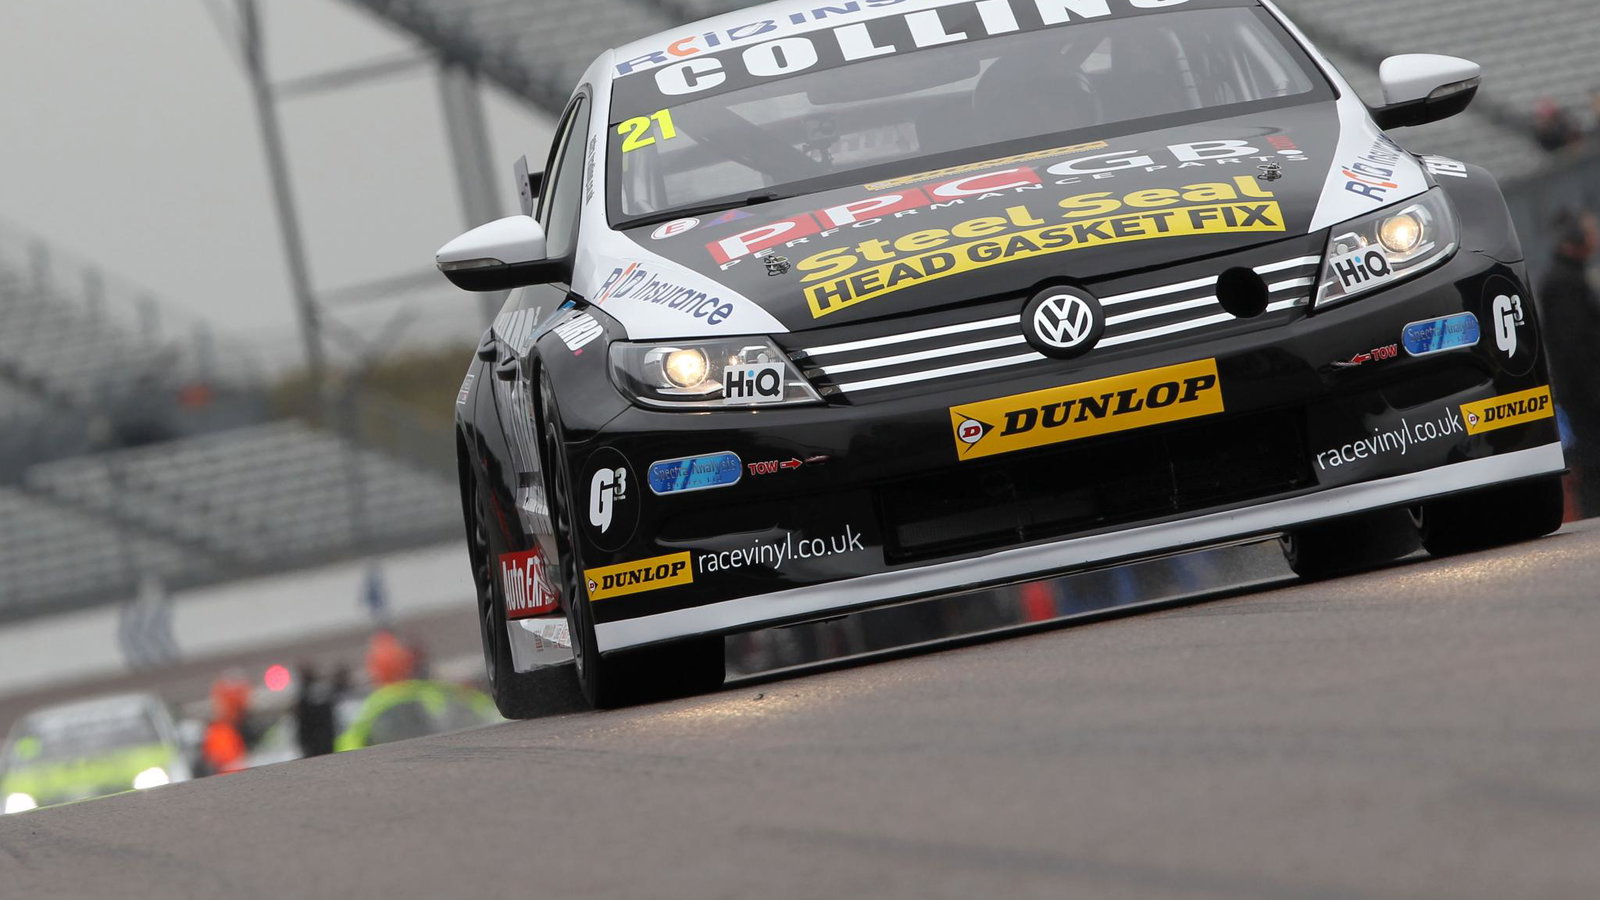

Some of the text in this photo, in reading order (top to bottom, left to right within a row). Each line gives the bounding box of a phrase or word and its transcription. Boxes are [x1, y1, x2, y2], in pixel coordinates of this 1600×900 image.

[655, 0, 1190, 95] COLLIN
[617, 109, 676, 152] 21
[719, 170, 1115, 271] PERFORMANCE
[1145, 154, 1308, 172] PARTS
[796, 175, 1274, 282] Steel Seal
[813, 204, 1278, 310] HEAD GASKET FIX
[1335, 251, 1391, 288] HiQ
[630, 273, 734, 325] Insurance
[1371, 344, 1397, 361] TOW
[725, 368, 780, 397] HiQ
[1000, 374, 1216, 437] DUNLOP
[1483, 394, 1549, 423] DUNLOP
[1317, 407, 1463, 470] racevinyl.co.uk
[748, 459, 779, 475] TOW
[699, 525, 864, 573] racevinyl.co.uk
[502, 559, 526, 611] Auto
[602, 560, 686, 590] DUNLOP
